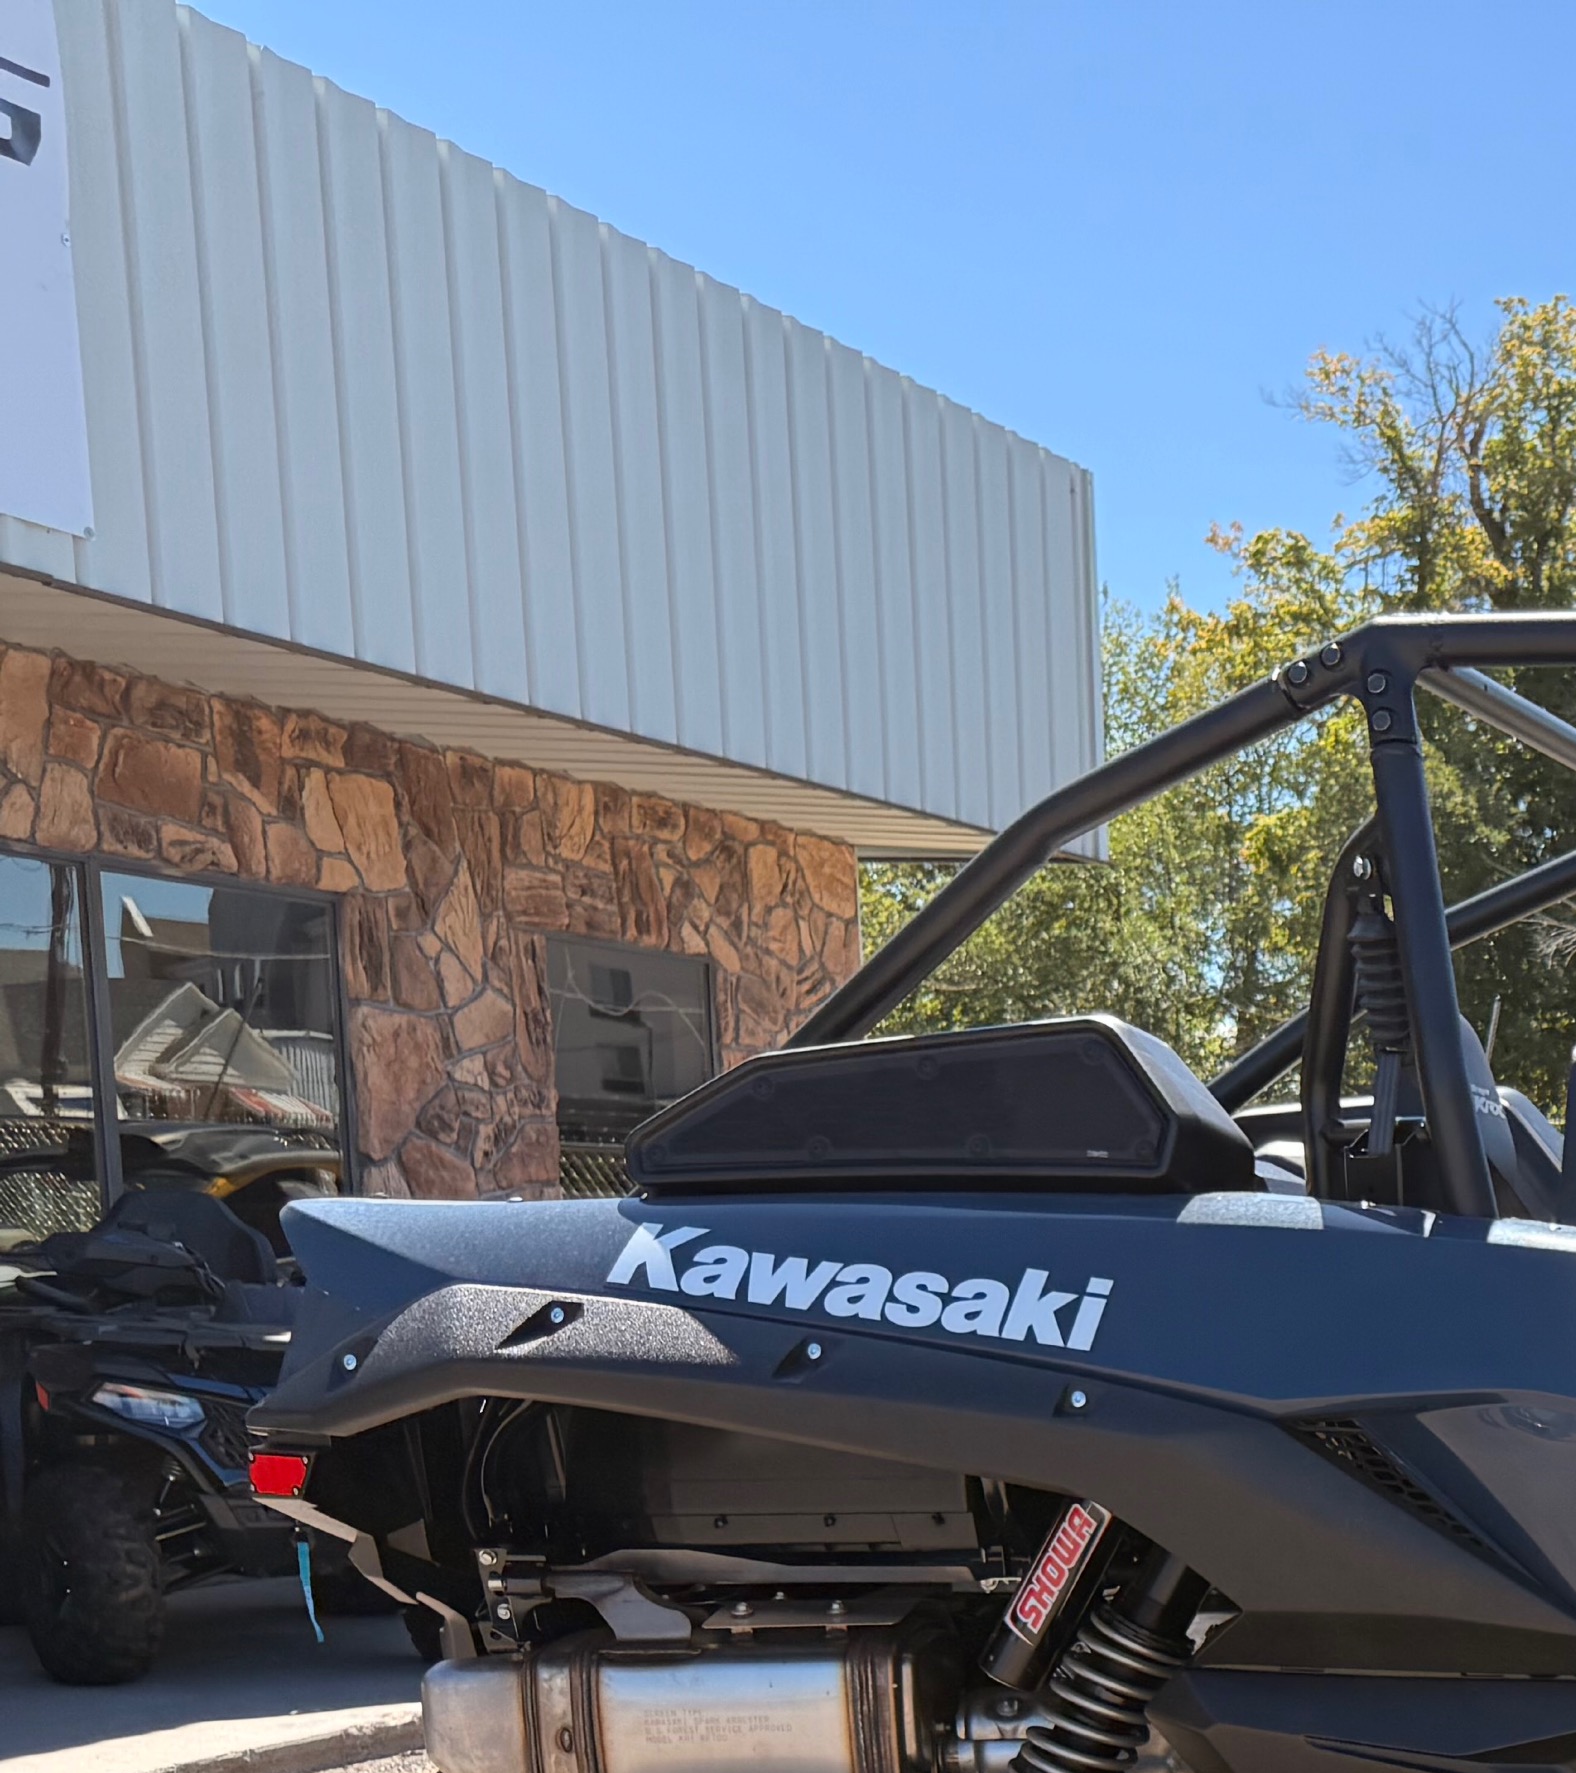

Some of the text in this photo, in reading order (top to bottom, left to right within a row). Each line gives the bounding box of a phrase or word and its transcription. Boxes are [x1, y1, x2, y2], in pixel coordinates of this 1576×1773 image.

[606, 1222, 1114, 1352] Kawasaki
[1016, 1503, 1098, 1635] SHOWA
[748, 1723, 793, 1733] APPROVED
